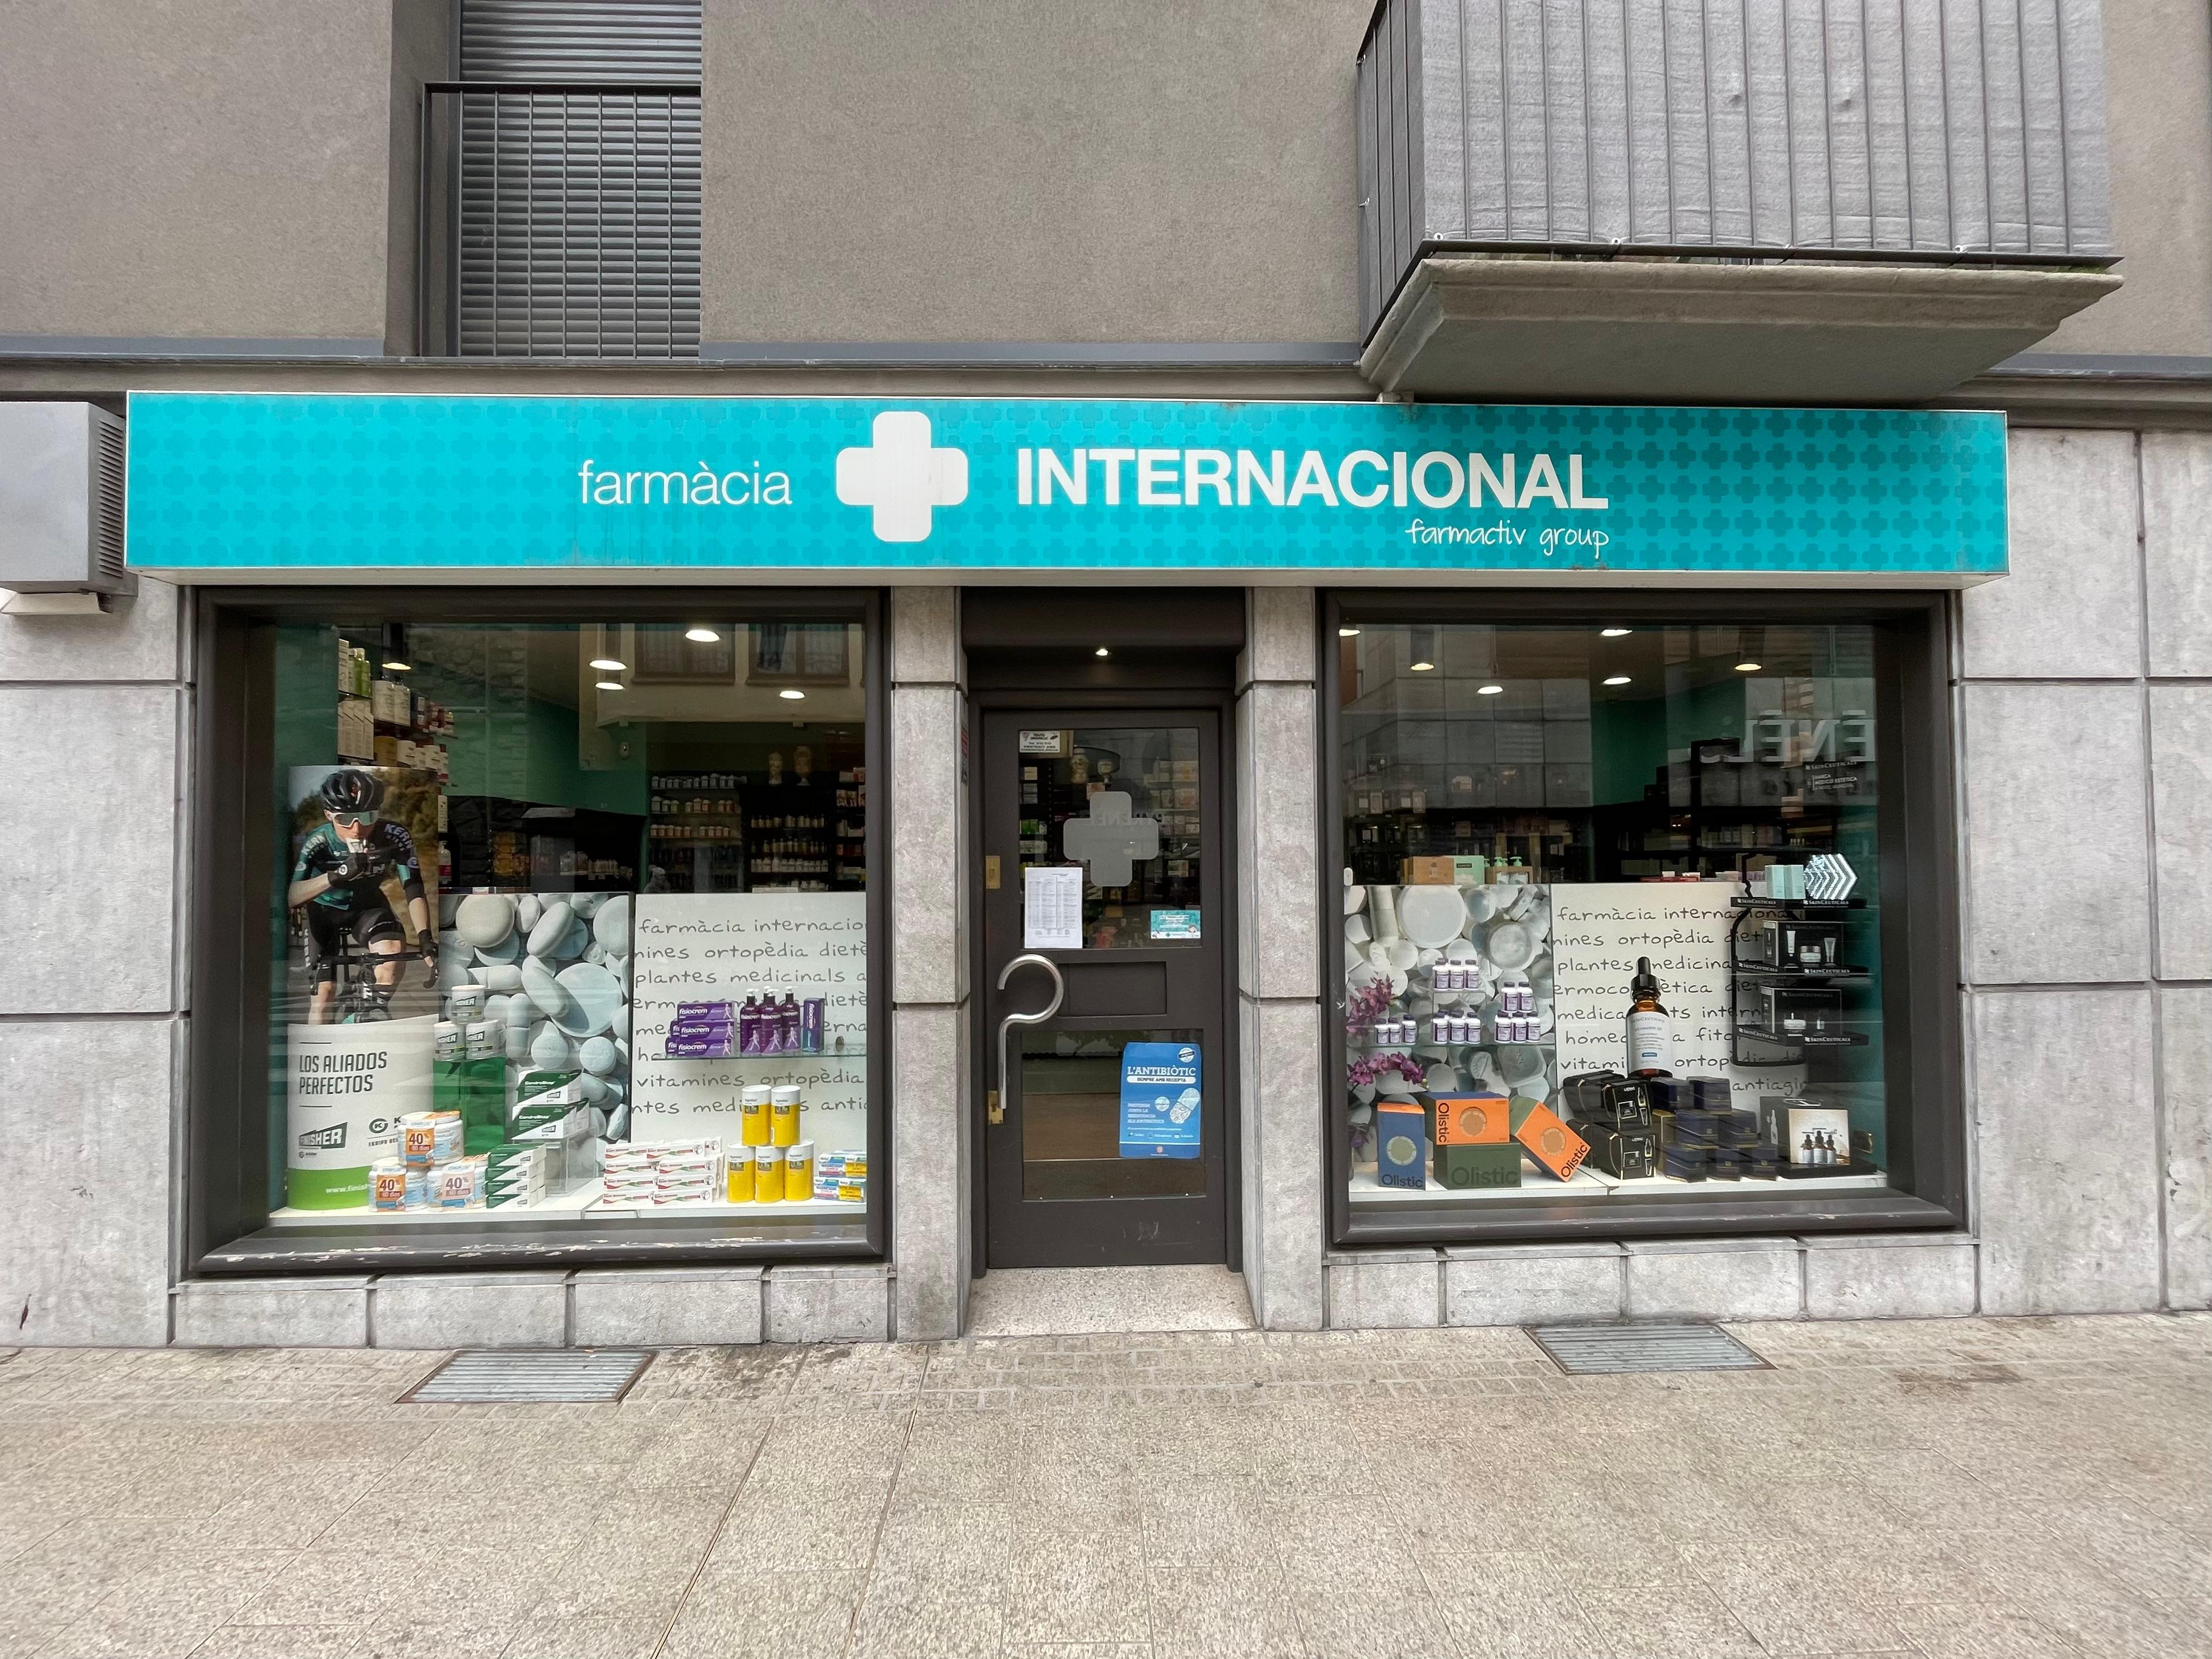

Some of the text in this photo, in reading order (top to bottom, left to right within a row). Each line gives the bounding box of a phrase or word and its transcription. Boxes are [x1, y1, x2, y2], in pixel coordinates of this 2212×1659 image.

[579, 459, 793, 506] farmàcia
[1017, 448, 1609, 510] INTERNACIONAL
[1405, 519, 1609, 558] farmactiv group
[1557, 907, 1656, 921] farmàcia
[638, 917, 866, 934] farmàcia internacio
[1618, 929, 1714, 949] ortopèdia
[704, 941, 809, 963] ortopèdia
[1558, 958, 1634, 976] plantes
[636, 970, 717, 989] plantes
[730, 967, 845, 983] medicinals
[1554, 978, 1712, 996] ermocoètica
[1558, 1005, 1691, 1020] medicats
[299, 1051, 388, 1073] LOS ALIADOS
[1127, 1065, 1196, 1076] L'ANTIBIÒTIC
[1560, 1057, 1625, 1070] vitami
[299, 1074, 374, 1094] PERFECTOS
[637, 1068, 865, 1090] vitamines ortopèdia
[1438, 1102, 1450, 1144] Olistic
[1560, 1143, 1588, 1178] Olistic
[1381, 1173, 1423, 1188] Olistic
[1451, 1166, 1520, 1187] Olistic
